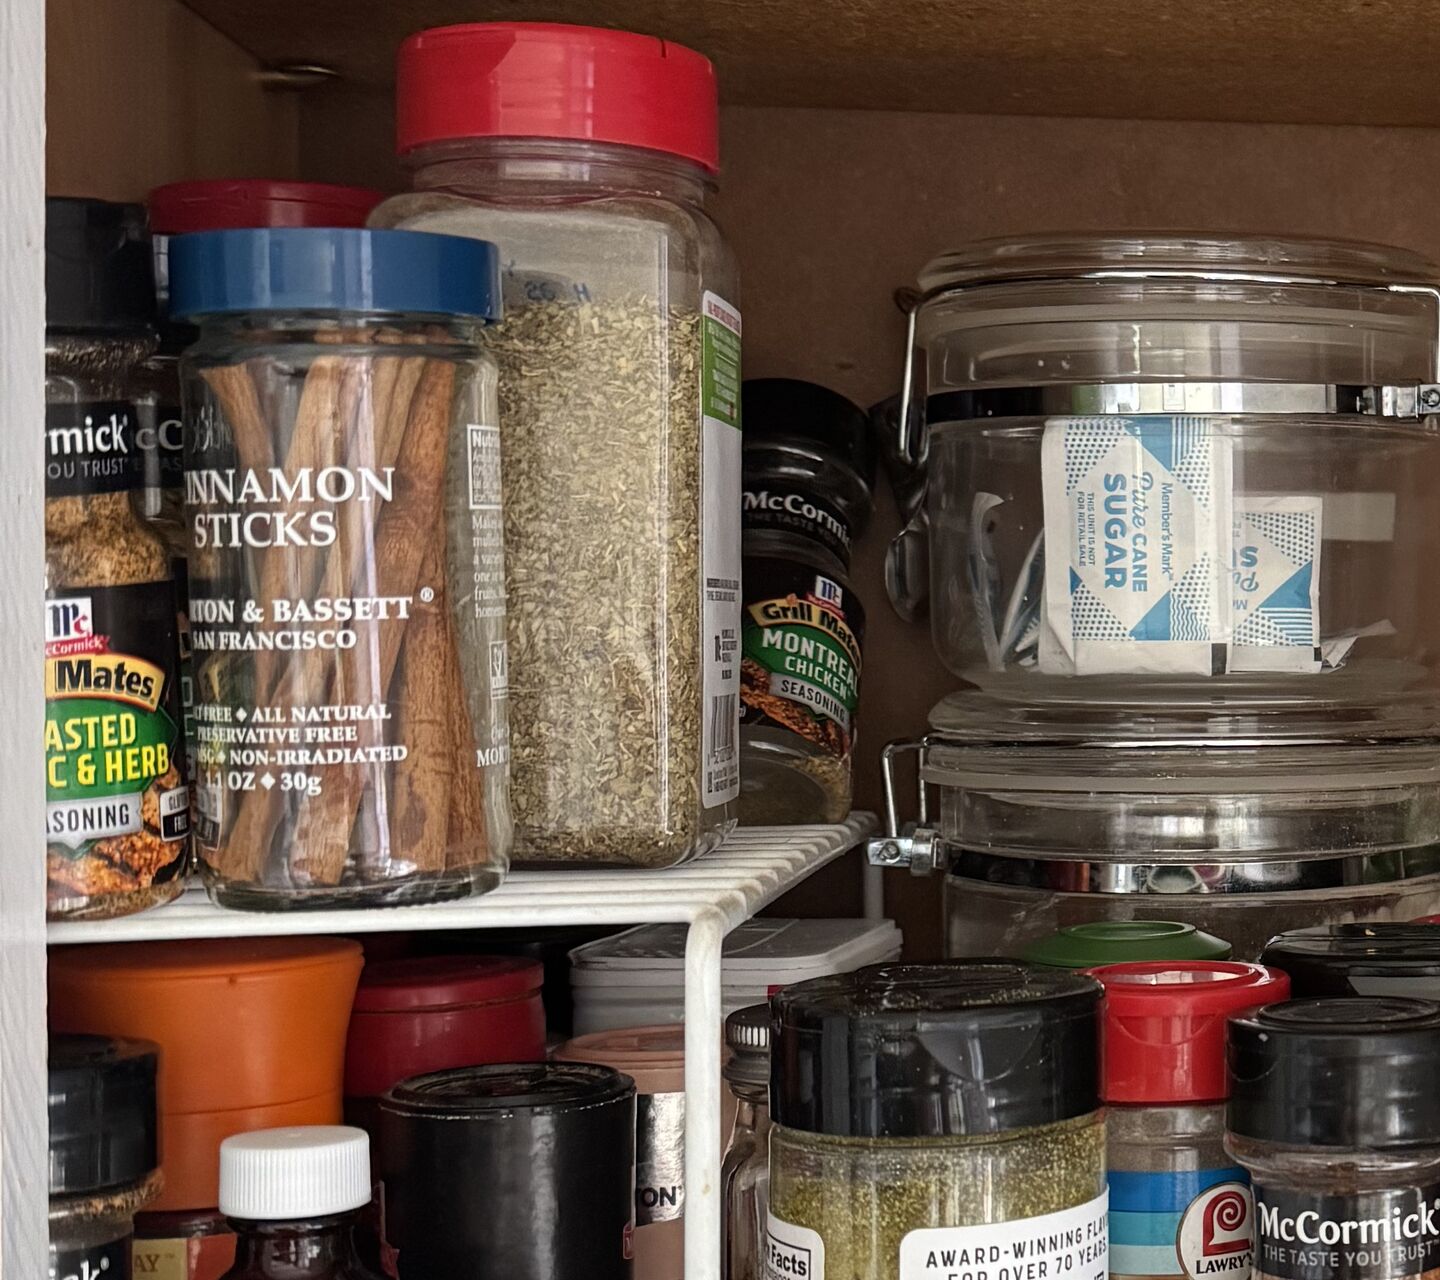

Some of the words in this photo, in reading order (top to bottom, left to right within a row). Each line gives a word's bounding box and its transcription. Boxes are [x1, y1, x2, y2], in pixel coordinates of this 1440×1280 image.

[184, 466, 395, 504] INNAMON
[1132, 471, 1153, 529] Pure
[1161, 482, 1173, 541] Member's
[194, 510, 337, 549] STICKS
[1104, 473, 1127, 589] SUGAR
[1132, 533, 1148, 592] CANE
[1161, 543, 1173, 574] Mark
[243, 599, 265, 622] &
[273, 595, 412, 622] BASSETT
[763, 601, 813, 623] Grill
[219, 628, 357, 651] FRANCISCO
[54, 659, 155, 699] Mates
[251, 707, 285, 722] ALL
[292, 703, 391, 722] NATURAL
[197, 726, 300, 743] PRESERVATIVE
[306, 726, 357, 743] FREE
[78, 751, 97, 787] &
[106, 743, 170, 780] HERB
[229, 745, 408, 766] NON-IRRADIATED
[280, 772, 322, 795] 30g
[1258, 1200, 1435, 1245] McCormick
[771, 1246, 808, 1278] Facts
[926, 1225, 1084, 1270] AWARD-WINNING
[1289, 1248, 1340, 1269] TASTE
[1345, 1249, 1383, 1267] YOU
[1388, 1242, 1433, 1266] TRUST
[1055, 1254, 1073, 1276] 70
[1196, 1252, 1253, 1275] LAWRY'S
